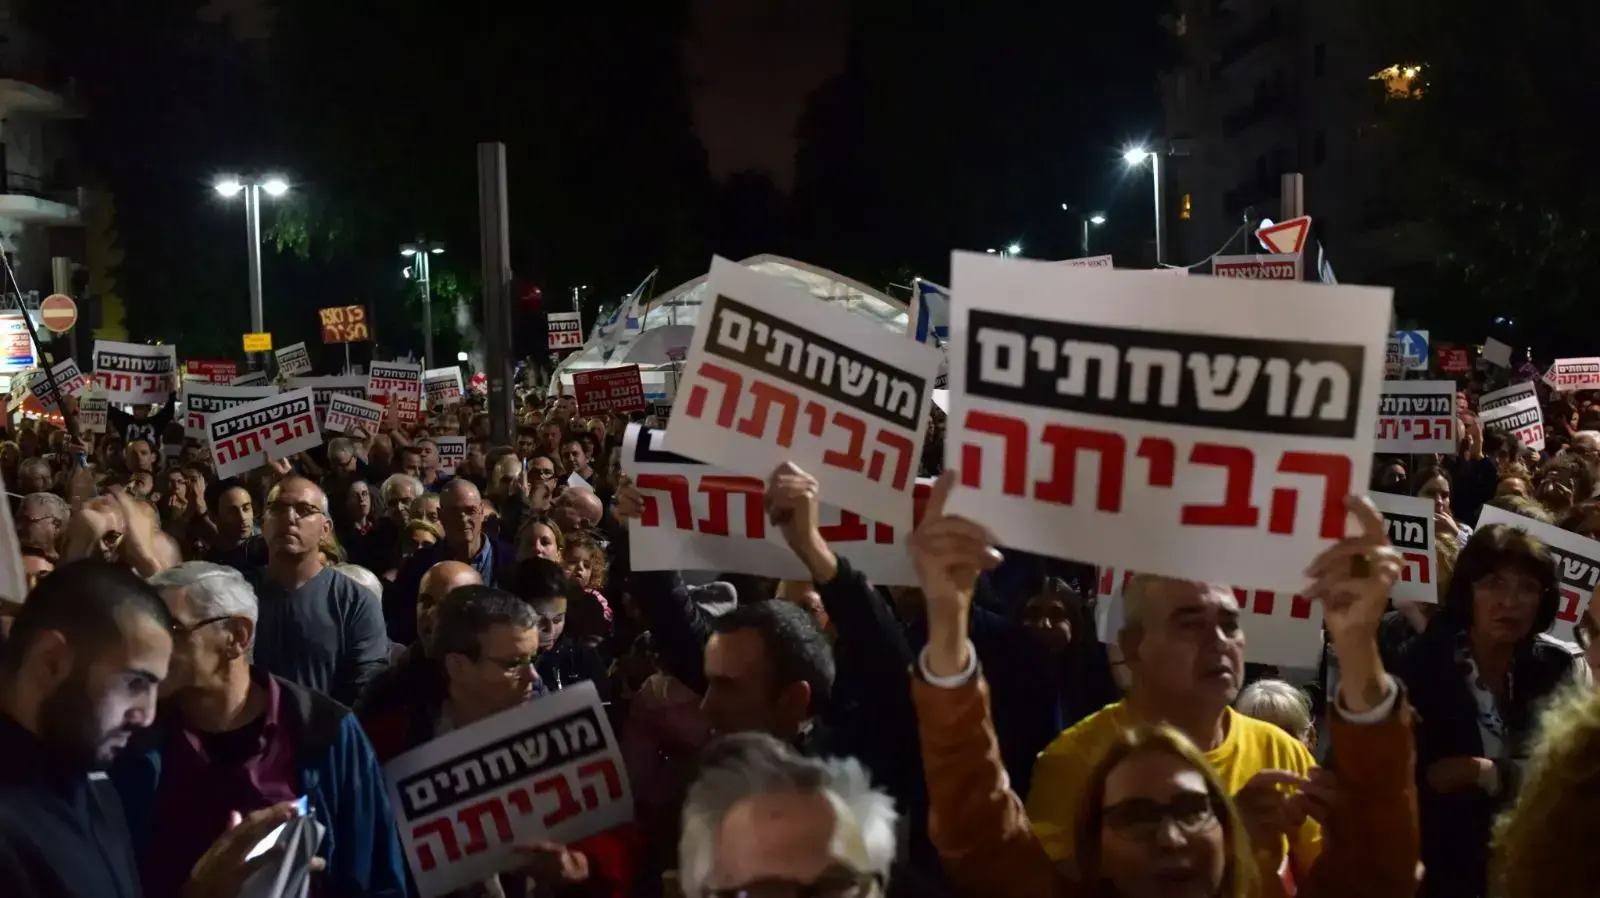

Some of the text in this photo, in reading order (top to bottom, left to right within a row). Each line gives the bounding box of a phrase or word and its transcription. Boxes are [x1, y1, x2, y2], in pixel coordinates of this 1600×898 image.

[100, 354, 170, 371] מושחתים
[373, 368, 417, 379] מושחתים
[716, 308, 916, 419] מושחתים
[1559, 364, 1599, 373] מושחתים
[95, 372, 171, 393] הביתה
[977, 327, 1351, 421] מושחתים
[1559, 374, 1600, 384] הביתה
[370, 379, 417, 392] הביתה
[214, 400, 307, 436] מושחתים
[334, 402, 379, 420] מושחתים
[686, 363, 914, 491] הביתה
[1378, 418, 1451, 440] הבית
[1515, 425, 1542, 445] הבי
[216, 415, 314, 464] הביתה
[962, 410, 1353, 539] הביתה
[405, 717, 598, 811] מושחתים
[413, 759, 622, 872] הביתה
